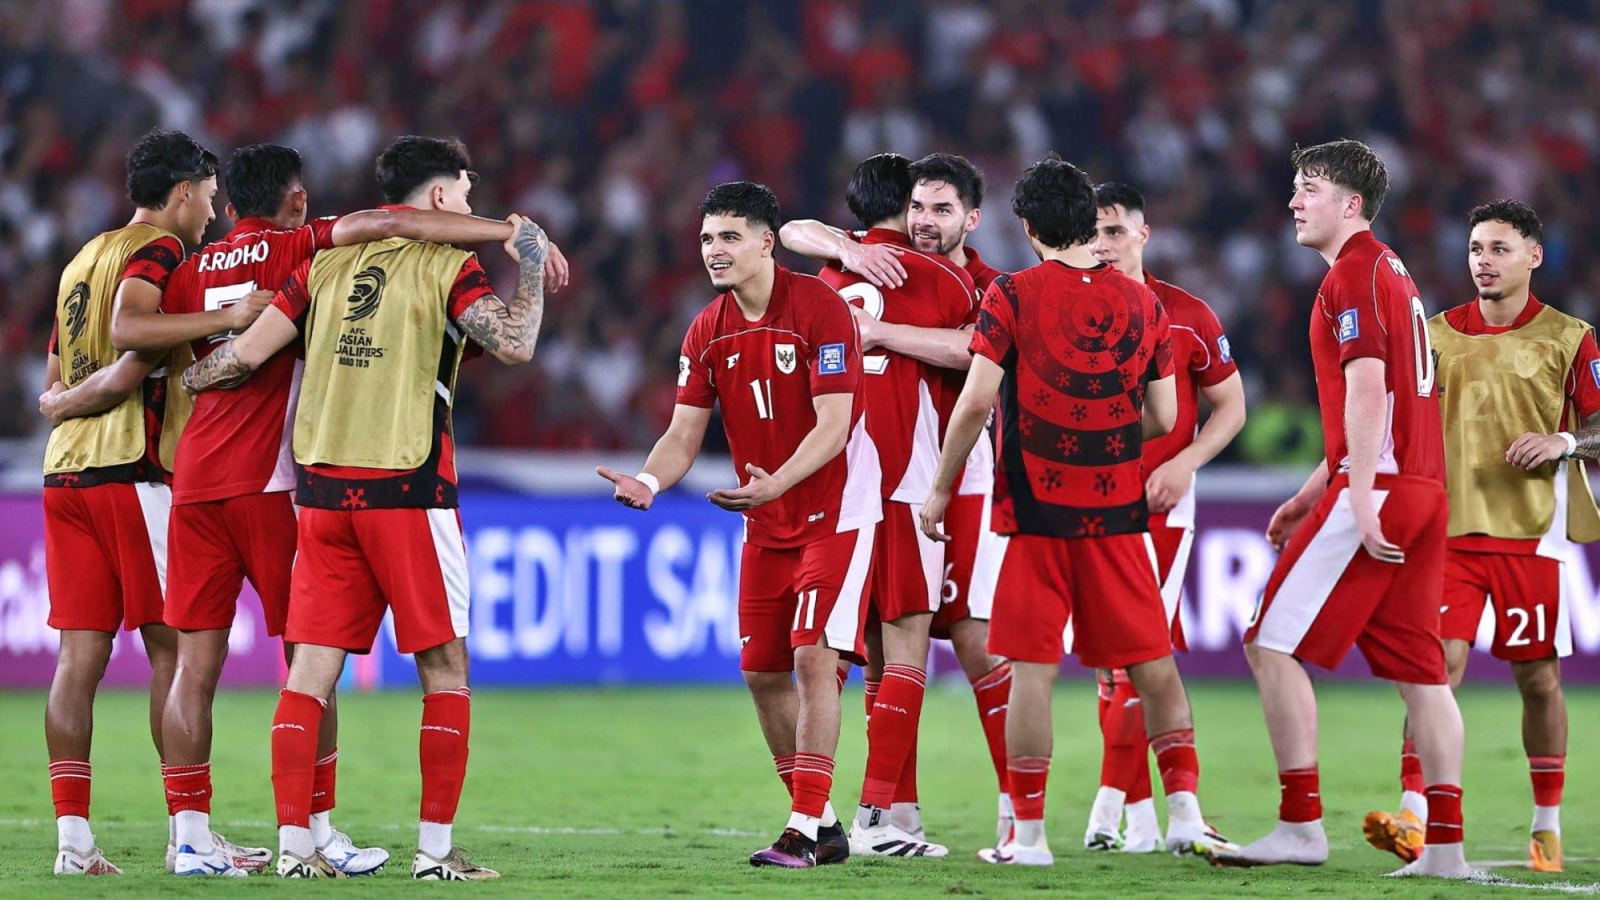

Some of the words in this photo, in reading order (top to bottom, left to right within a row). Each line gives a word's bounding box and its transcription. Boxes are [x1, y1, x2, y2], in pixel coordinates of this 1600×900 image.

[339, 333, 373, 347] ASIAN
[349, 327, 366, 335] AFC
[334, 344, 384, 358] UALIFIERS
[71, 353, 90, 371] ASIAN
[748, 378, 774, 420] 11
[792, 588, 818, 631] 11
[1505, 603, 1546, 647] 21
